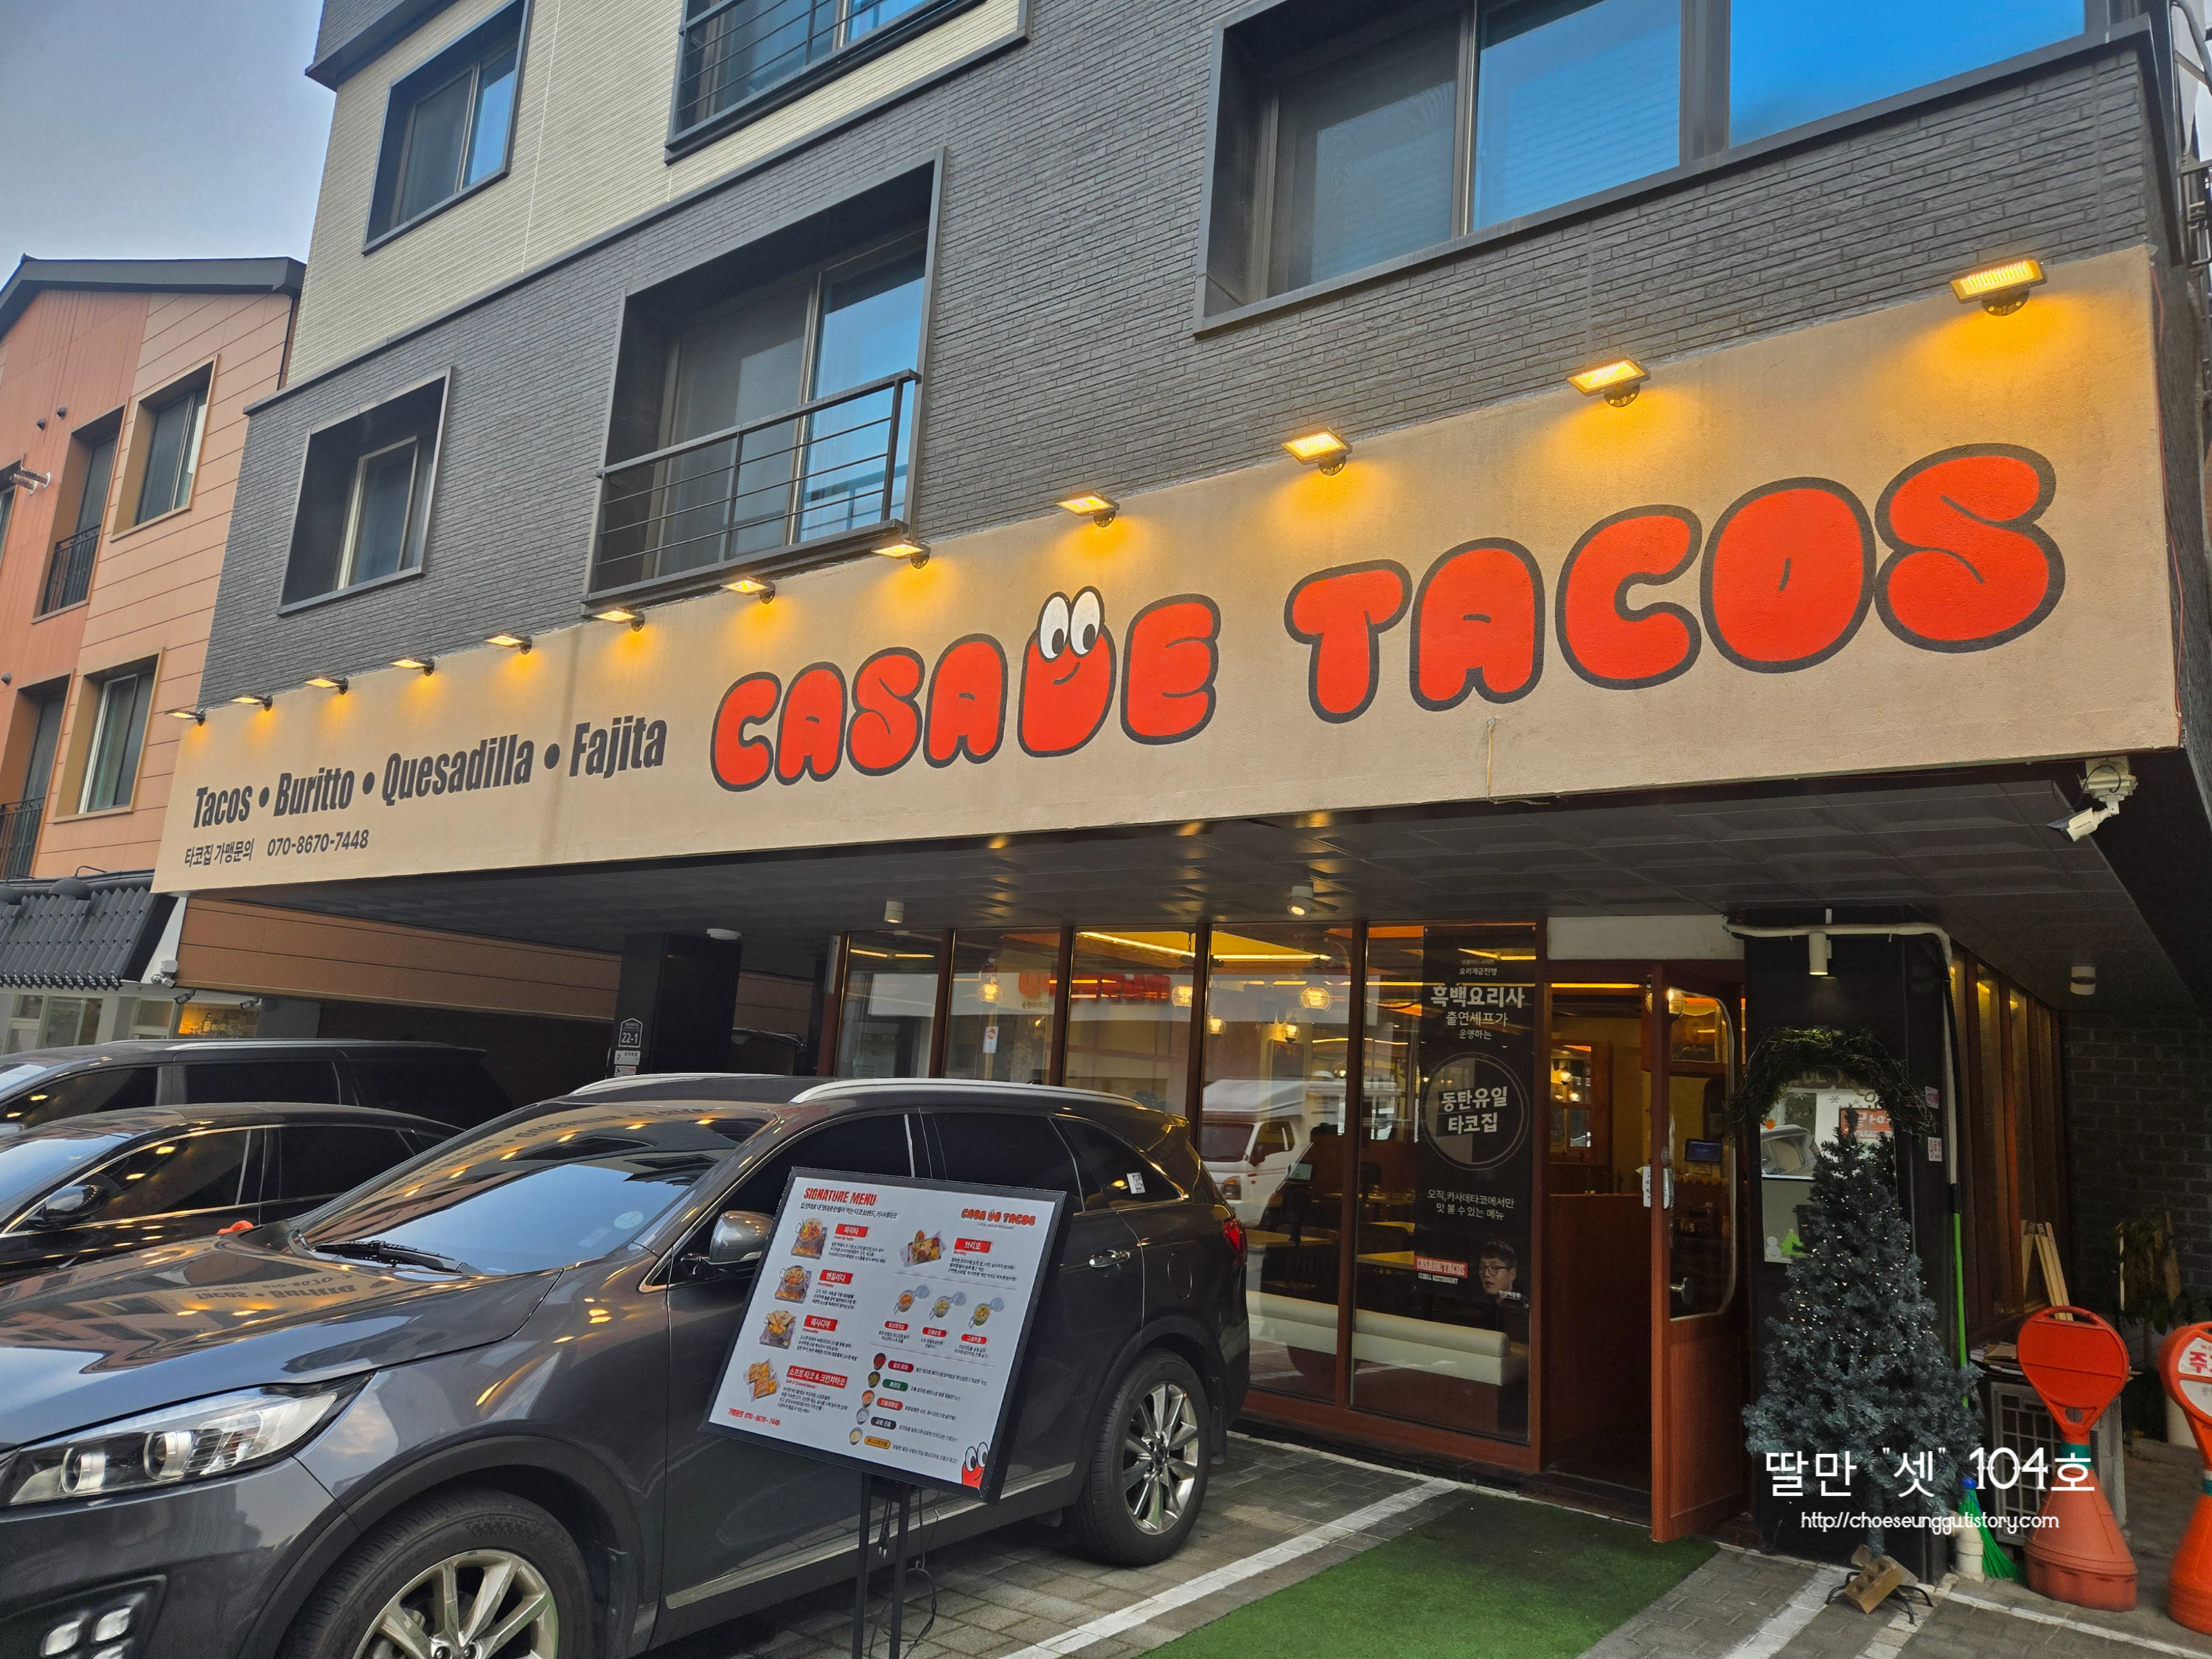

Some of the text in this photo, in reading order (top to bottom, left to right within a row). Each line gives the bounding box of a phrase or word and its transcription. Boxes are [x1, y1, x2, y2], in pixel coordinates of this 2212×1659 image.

[1284, 442, 2065, 724] TACOS
[193, 715, 668, 829] Tacos Buritto Quesadilla Fajita
[184, 829, 369, 868] 타코집 가맹문의 070-8670-7448
[1430, 986, 1525, 1008] 흑백요리사
[1446, 1011, 1508, 1026] 출연셰프가
[621, 1032, 639, 1044] 22-1
[1458, 1029, 1492, 1040] 운영하는
[1441, 1086, 1508, 1113] 동탄유일
[1448, 1112, 1498, 1135] 타코집
[804, 1188, 877, 1206] SIGNATURE MENU
[961, 1208, 987, 1220] CASA
[1002, 1213, 1037, 1225] TACOS
[1436, 1203, 1445, 1214] 맛
[1457, 1206, 1465, 1216] 수
[1467, 1206, 1484, 1218] 있는
[1486, 1209, 1504, 1220] 메뉴
[844, 1226, 859, 1234] 파히타
[964, 1241, 981, 1250] 브리또
[2190, 1351, 2212, 1374] 주
[789, 1368, 846, 1385] 소프트 타코 & 크런치타코
